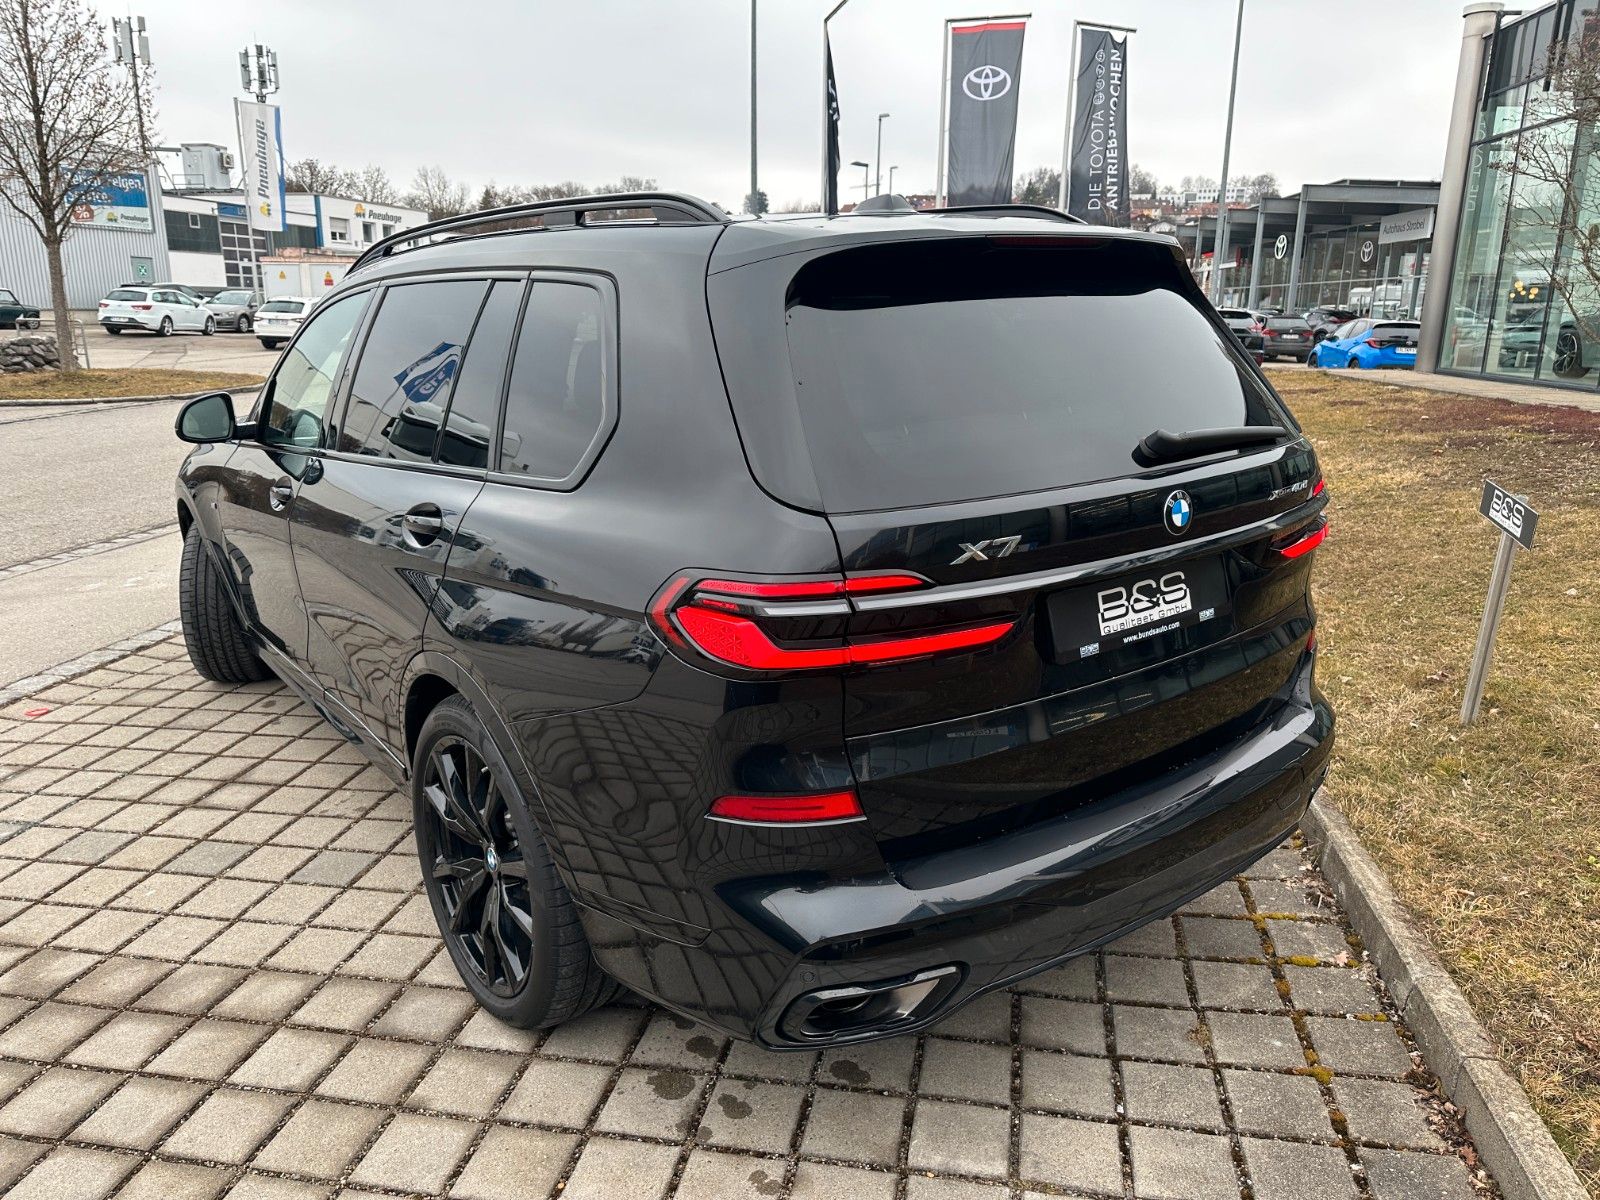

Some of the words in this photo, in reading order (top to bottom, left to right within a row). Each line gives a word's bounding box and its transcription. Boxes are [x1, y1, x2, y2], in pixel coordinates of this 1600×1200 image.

[255, 118, 270, 200] Pneuhage
[1090, 110, 1105, 177] TOYOTA
[1088, 183, 1103, 210] DIE
[368, 209, 402, 223] Pneuhage
[1383, 222, 1406, 235] Autohaus
[1491, 488, 1525, 529] B&S
[949, 535, 1022, 565] X7
[1098, 571, 1188, 623] B&S
[1103, 613, 1155, 635] Qualitaet
[1158, 602, 1188, 617] GmbH
[1123, 621, 1181, 644] www.bundsauto.com
